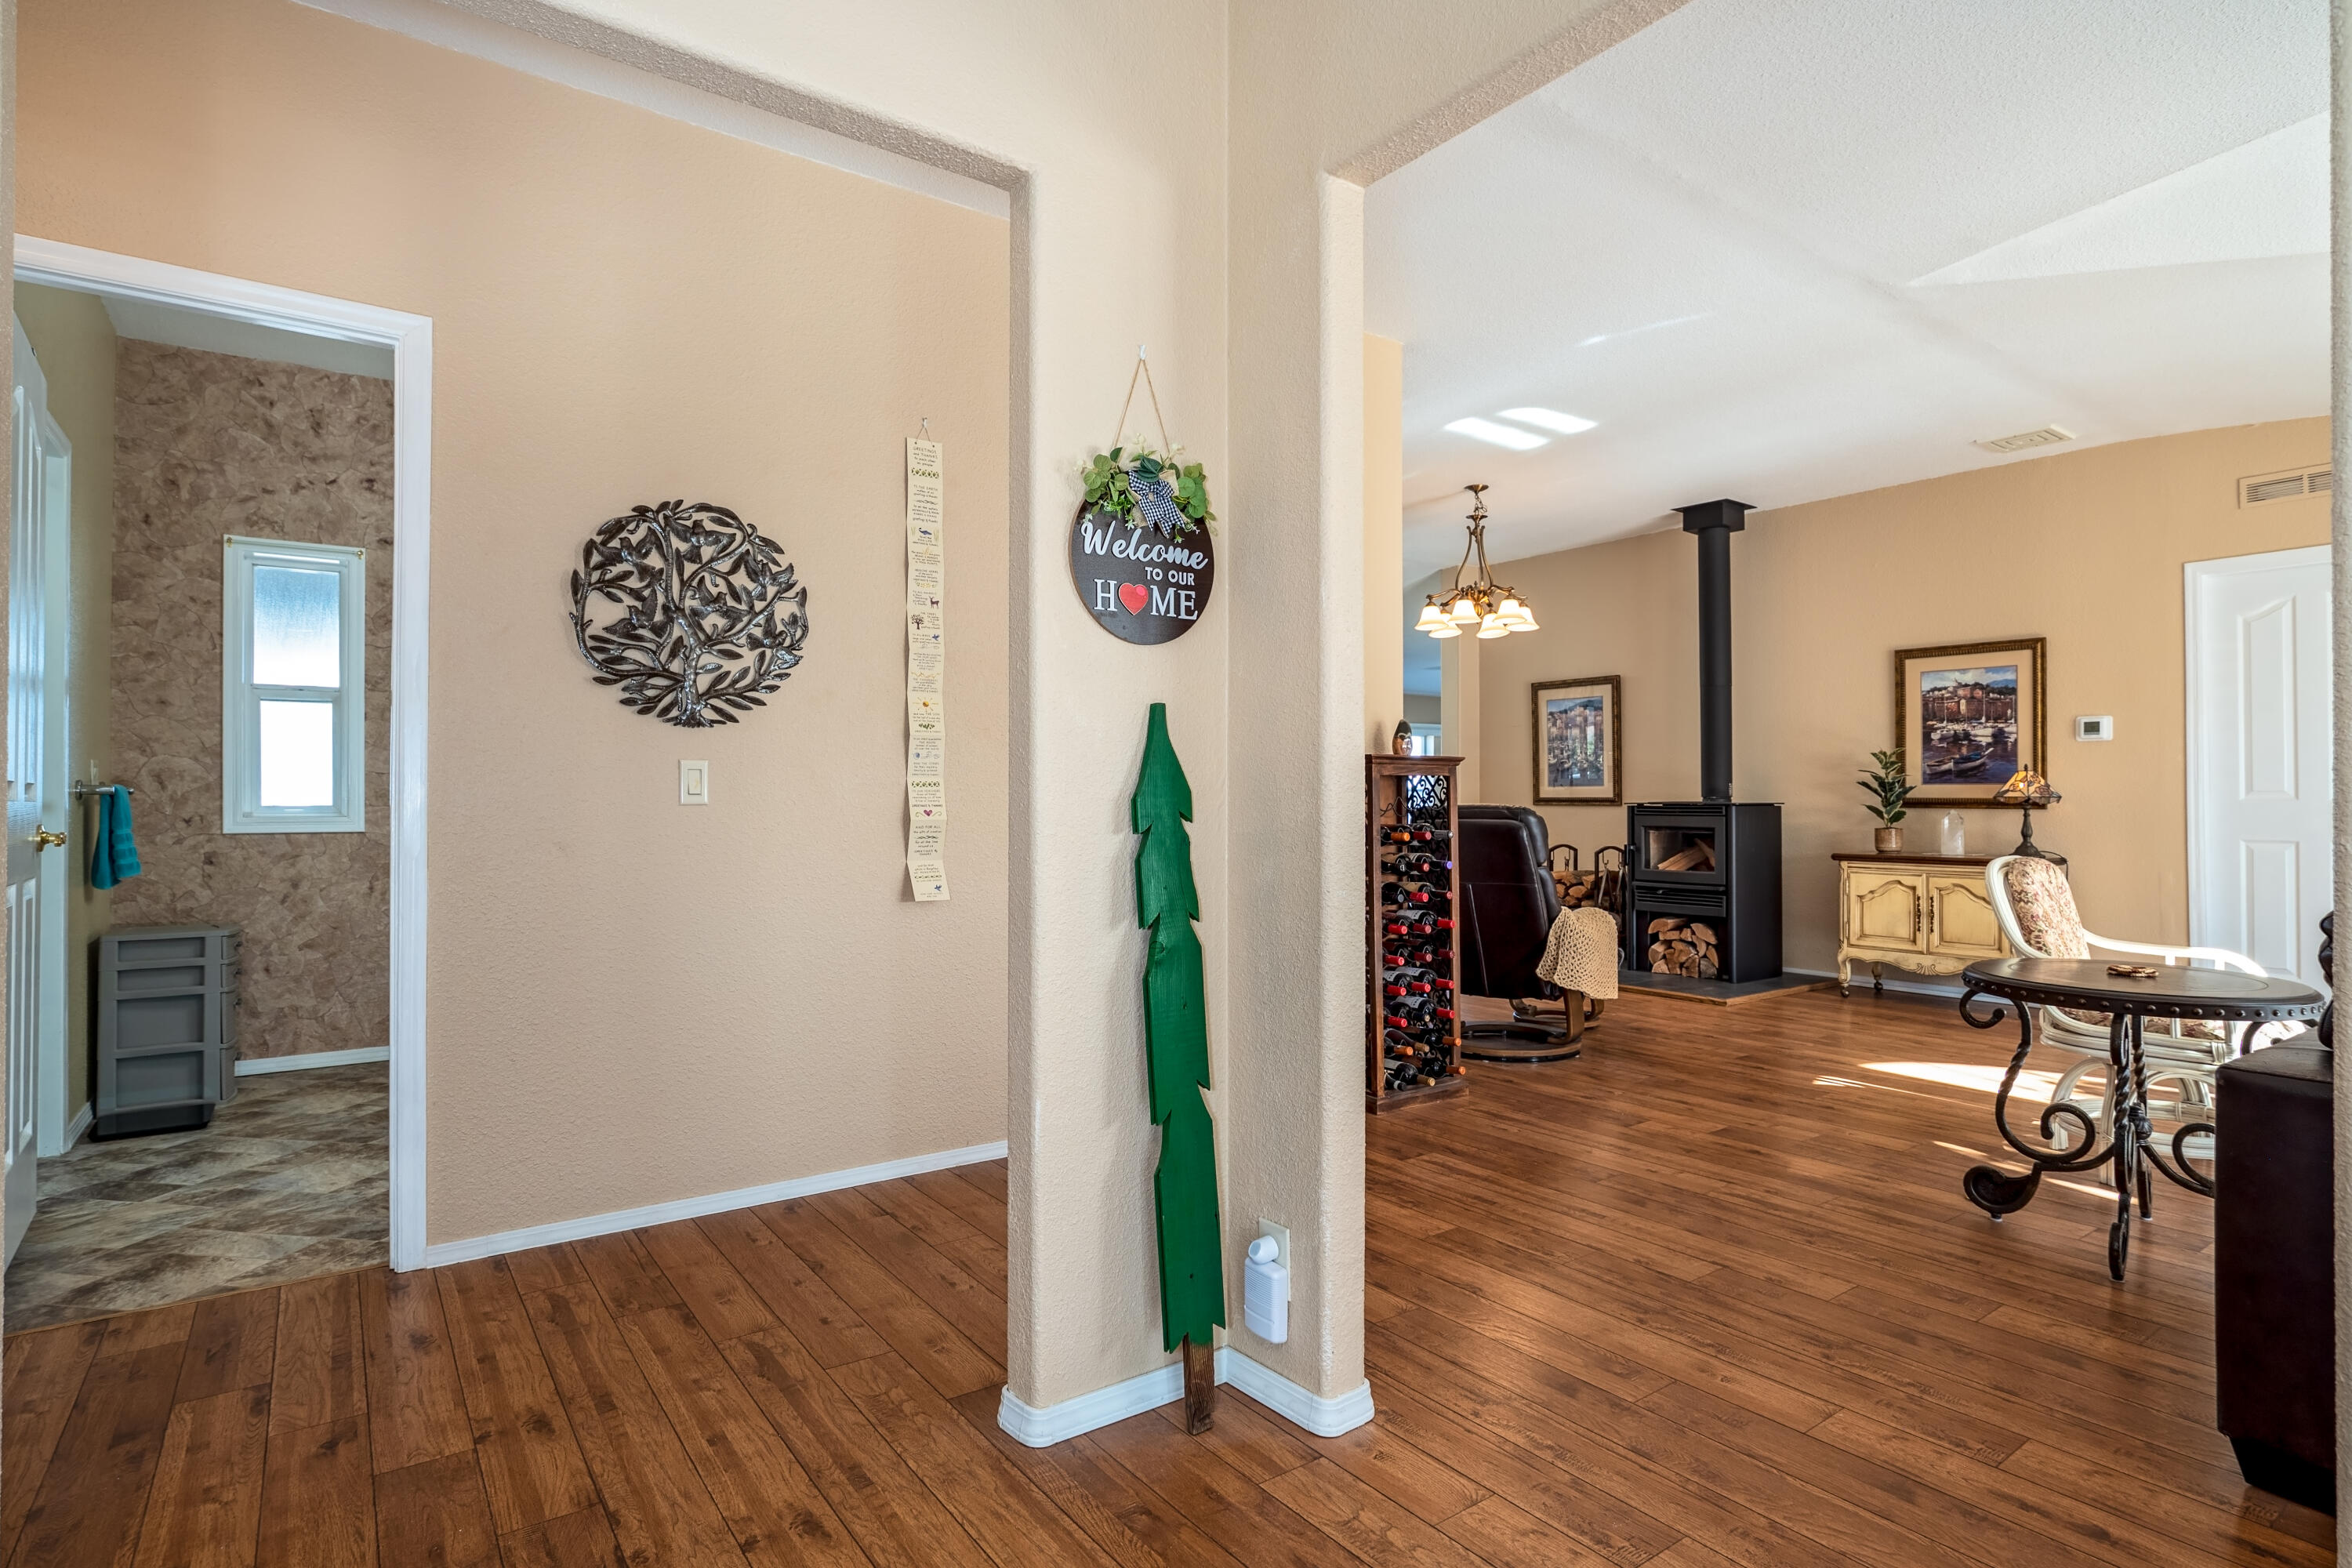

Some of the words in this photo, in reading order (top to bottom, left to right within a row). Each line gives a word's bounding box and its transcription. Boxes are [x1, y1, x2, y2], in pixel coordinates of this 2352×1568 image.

[1080, 520, 1208, 570] Welcome
[1145, 566, 1163, 581] TO
[1168, 570, 1195, 586] OUR
